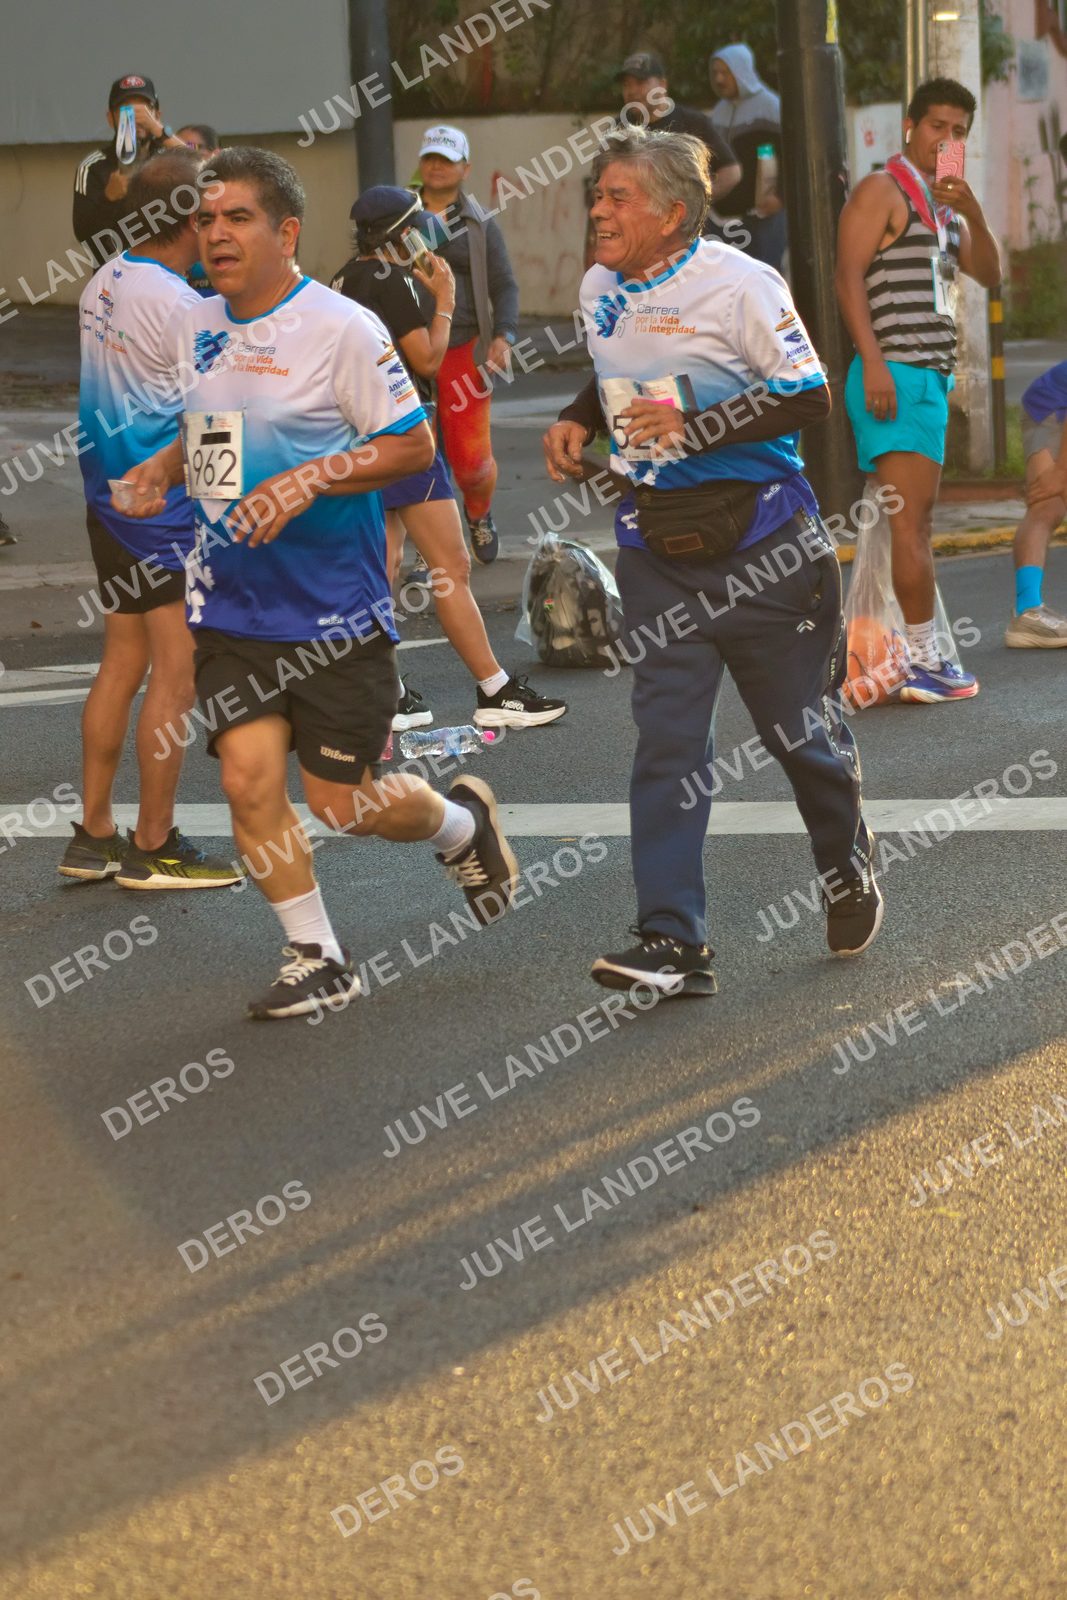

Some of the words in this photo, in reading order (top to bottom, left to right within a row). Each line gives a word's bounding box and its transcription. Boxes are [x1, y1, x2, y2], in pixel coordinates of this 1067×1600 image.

[637, 303, 680, 315] Carrera
[635, 316, 648, 326] por
[660, 315, 680, 325] Vida
[648, 324, 696, 336] Integridad
[237, 341, 277, 355] Carrera
[256, 354, 273, 365] Vida
[245, 363, 290, 377] Integridad
[192, 448, 237, 487] 962
[501, 699, 525, 712] HOKA
[320, 745, 356, 763] Wilson
